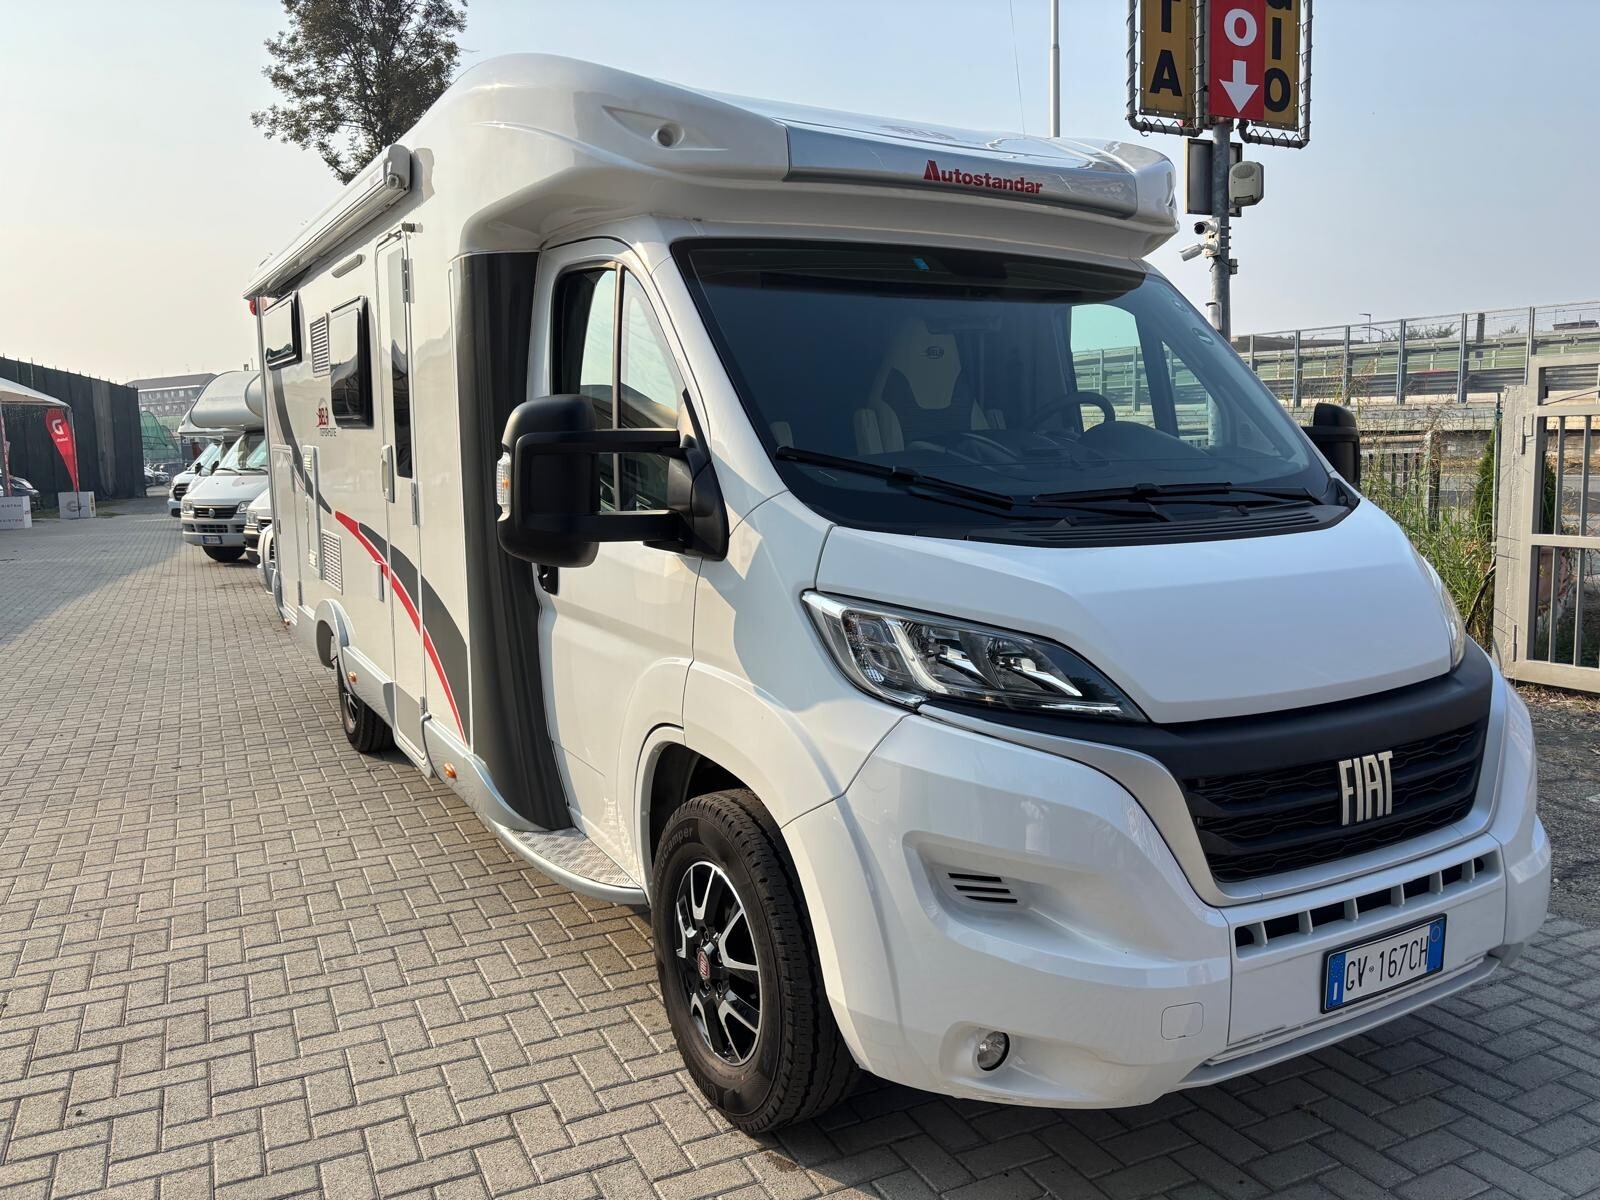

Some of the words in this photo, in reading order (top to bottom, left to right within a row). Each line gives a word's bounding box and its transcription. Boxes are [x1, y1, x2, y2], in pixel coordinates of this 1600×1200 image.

[923, 159, 1044, 194] Autostandar
[1338, 750, 1393, 826] FIAT
[1345, 955, 1368, 991] GV
[1379, 935, 1429, 982] 167CH
